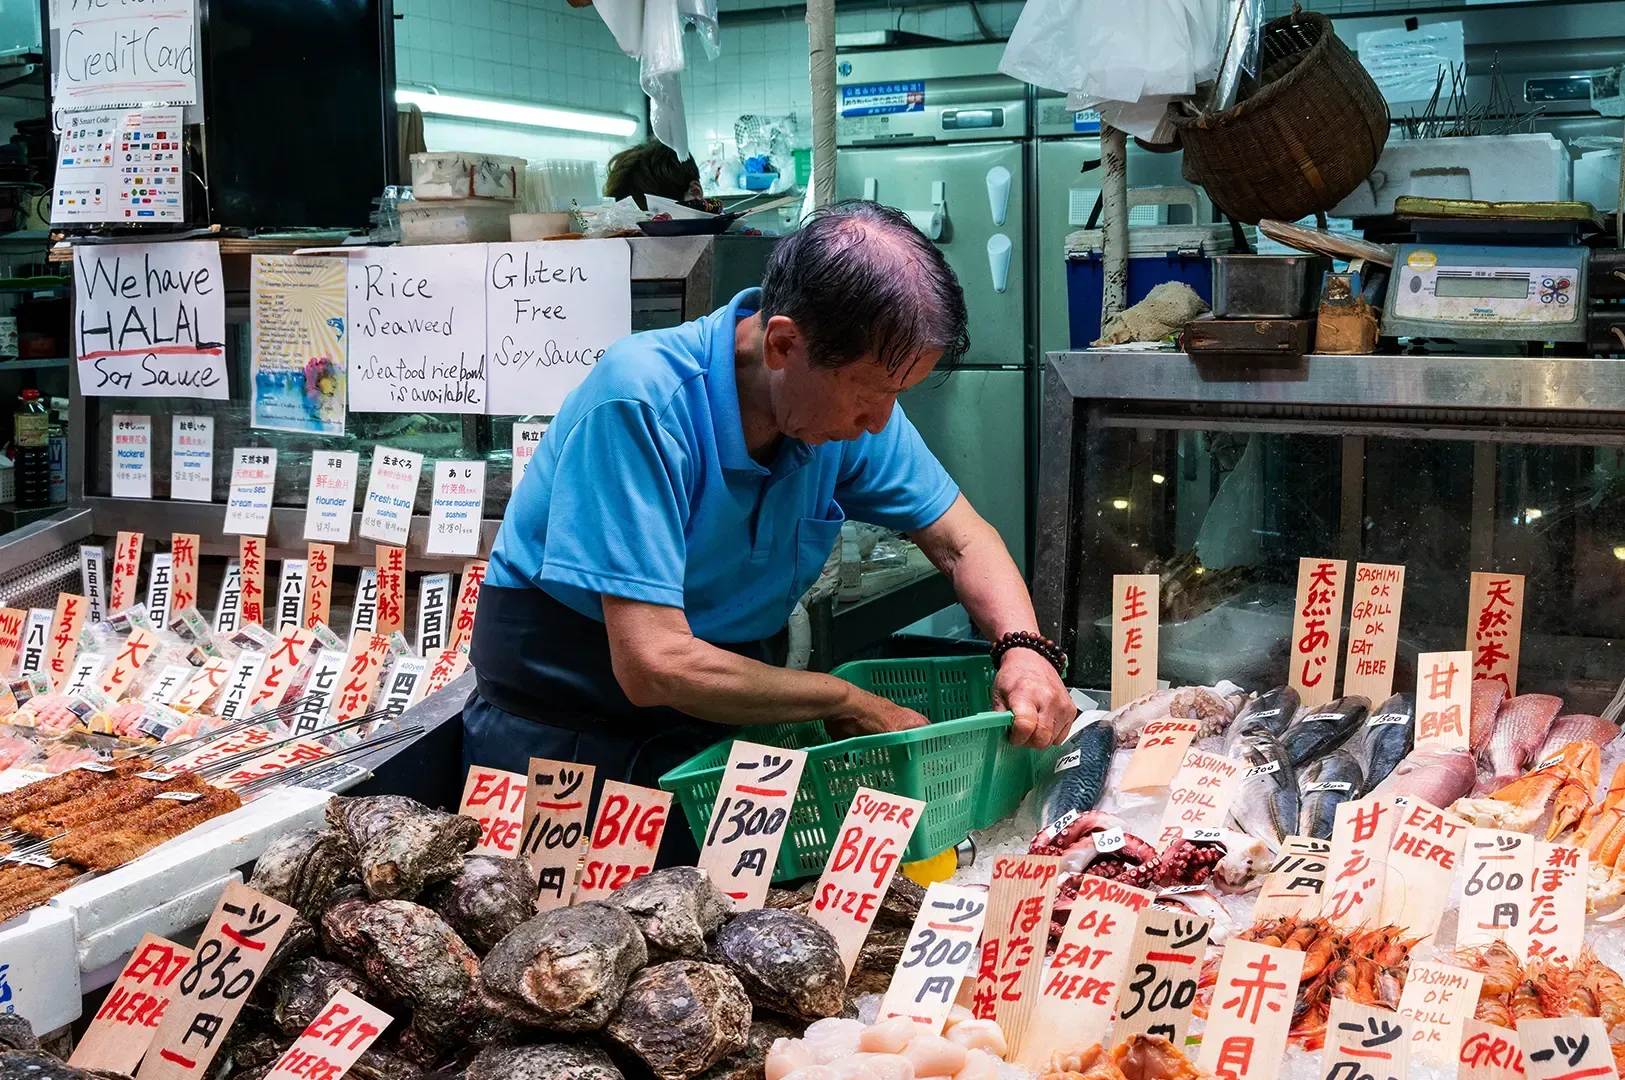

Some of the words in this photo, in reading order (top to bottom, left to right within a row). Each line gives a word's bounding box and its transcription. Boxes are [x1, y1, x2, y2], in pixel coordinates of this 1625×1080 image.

[66, 29, 142, 81] Credit
[145, 25, 196, 77] Card
[96, 116, 110, 124] Code
[80, 255, 140, 300] We
[146, 253, 213, 299] have
[492, 252, 588, 290] Gluten
[513, 298, 567, 324] Free
[81, 300, 227, 357] HALAL
[493, 336, 534, 372] Soy
[535, 339, 605, 368] Sauce
[142, 354, 220, 387] Sauce
[390, 383, 406, 402] is
[118, 449, 146, 458] Mackerel
[327, 458, 342, 468] 平目
[382, 455, 413, 469] 生まぐろ
[231, 498, 252, 507] bream
[254, 486, 266, 494] sea
[316, 497, 347, 506] flounder
[369, 492, 392, 504] Fresh
[393, 497, 410, 509] tuna
[434, 498, 453, 506] Horse
[454, 499, 480, 508] mackerel
[376, 508, 398, 519] sashimi
[172, 536, 194, 610] 新いか
[242, 540, 262, 625] 天然本鯛
[387, 550, 403, 626] 生まぐろ
[1356, 568, 1400, 583] SASHIMI
[150, 566, 171, 629] 五百円
[308, 550, 328, 629] 活ひらめ
[1370, 584, 1390, 597] OK
[453, 566, 485, 651] 天然あじ
[1352, 600, 1392, 620] GRILL
[1121, 586, 1148, 676] 生たこ
[1298, 563, 1337, 688] 天然あじ
[1365, 622, 1384, 636] OK
[22, 624, 44, 677] 八百
[1350, 640, 1374, 656] EAT
[400, 662, 424, 670] 400yen
[1356, 658, 1386, 676] HERE
[1416, 661, 1464, 742] 甘鯛
[1143, 736, 1177, 749] OK
[1144, 721, 1198, 736] GRILL
[736, 754, 794, 783] 一ツ
[1182, 752, 1238, 777] SASHIMI
[1245, 764, 1274, 778] 1300
[466, 772, 528, 814] EAT
[535, 767, 584, 800] 一ツ
[1196, 776, 1222, 788] OK
[851, 794, 914, 830] SUPER
[1172, 788, 1217, 809] GRILL
[592, 794, 666, 850] BIG
[706, 797, 787, 847] 1300
[1054, 814, 1073, 833] 850
[1182, 809, 1206, 822] OK
[1404, 805, 1466, 838] EAT
[478, 816, 522, 852] ERE
[520, 812, 582, 854] 1100
[1194, 830, 1221, 838] 900
[1473, 835, 1522, 852] 一ツ
[732, 847, 767, 877] 円
[830, 826, 898, 888] BIG
[1270, 856, 1326, 874] 110
[1330, 802, 1388, 921] 甘えび
[1392, 831, 1456, 870] HERE
[536, 866, 566, 901] 円
[581, 859, 651, 890] SIZE
[992, 858, 1057, 890] SCALOP
[1286, 876, 1324, 894] 円
[1464, 861, 1524, 897] 600
[814, 882, 878, 924] SIZE
[931, 898, 985, 923] 一ツ
[1077, 878, 1150, 912] SASHIMI
[222, 902, 281, 937] 一ツ
[1077, 910, 1116, 938] OK
[1492, 902, 1519, 928] 円
[902, 928, 972, 968] 300
[1000, 895, 1046, 1002] ほたて
[1144, 918, 1210, 950] 一ツ
[122, 942, 191, 987] EAT
[180, 939, 255, 1001] 850
[1050, 942, 1113, 970] EAT
[914, 976, 954, 1003] 円
[1044, 970, 1116, 1006] HERE
[1120, 963, 1198, 1020] 300
[1408, 967, 1469, 990] SASHIMI
[94, 986, 170, 1028] HERE
[1424, 990, 1453, 1005] OK
[182, 1012, 224, 1049] 円
[300, 1003, 380, 1052] EAT
[1338, 1016, 1404, 1048] 一ツ
[1412, 1029, 1442, 1043] OK
[1460, 1032, 1525, 1074] GRIL
[1530, 1034, 1590, 1068] 一ツ
